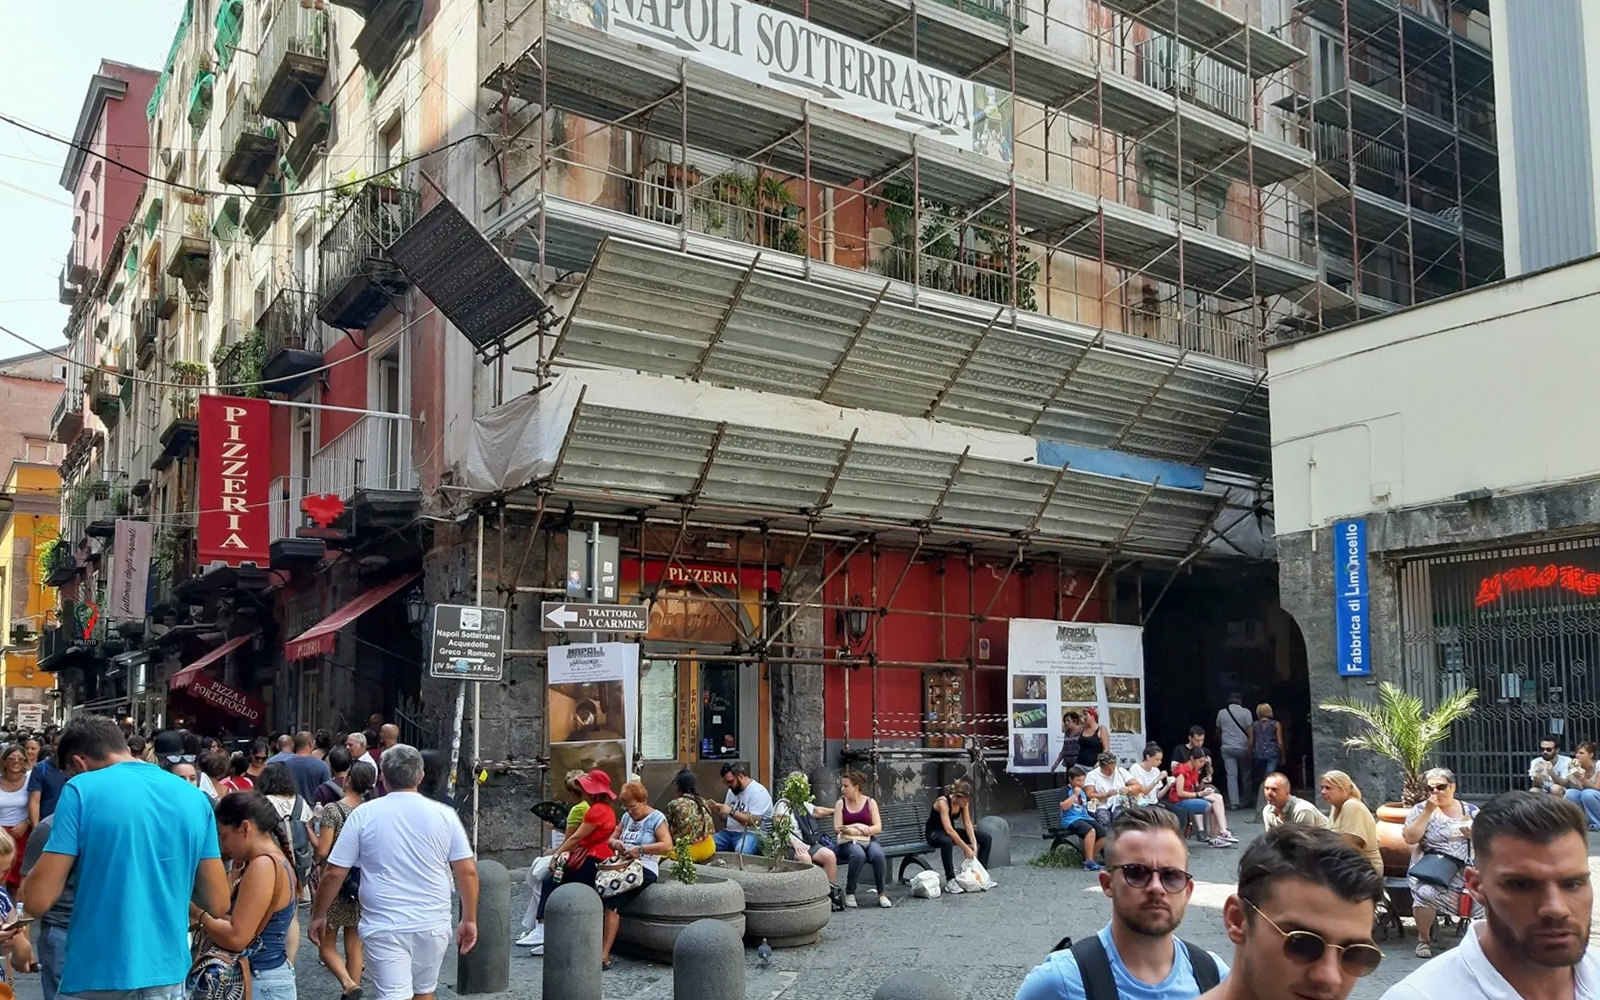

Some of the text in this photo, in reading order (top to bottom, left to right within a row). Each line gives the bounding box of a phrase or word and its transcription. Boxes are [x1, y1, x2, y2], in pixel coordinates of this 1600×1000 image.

[757, 12, 971, 131] SOTTERRANEA
[219, 406, 249, 549] PIZZERIA
[124, 558, 137, 579] degli
[668, 567, 738, 584] PIZZERIA
[121, 581, 134, 615] fattoria
[1349, 599, 1360, 612] di
[587, 608, 638, 618] TRATTORIA
[1481, 608, 1529, 619] FABRICA
[579, 618, 594, 628] DA
[596, 618, 646, 630] CARMINE
[436, 629, 501, 641] Napoli Sotterranea
[1346, 615, 1362, 672] Fabbrica
[439, 647, 462, 656] Greco
[466, 649, 496, 658] Romano
[448, 639, 489, 649] Acquedotto
[193, 682, 259, 720] PORTAFOGLIO
[211, 681, 247, 705] PIZZA A
